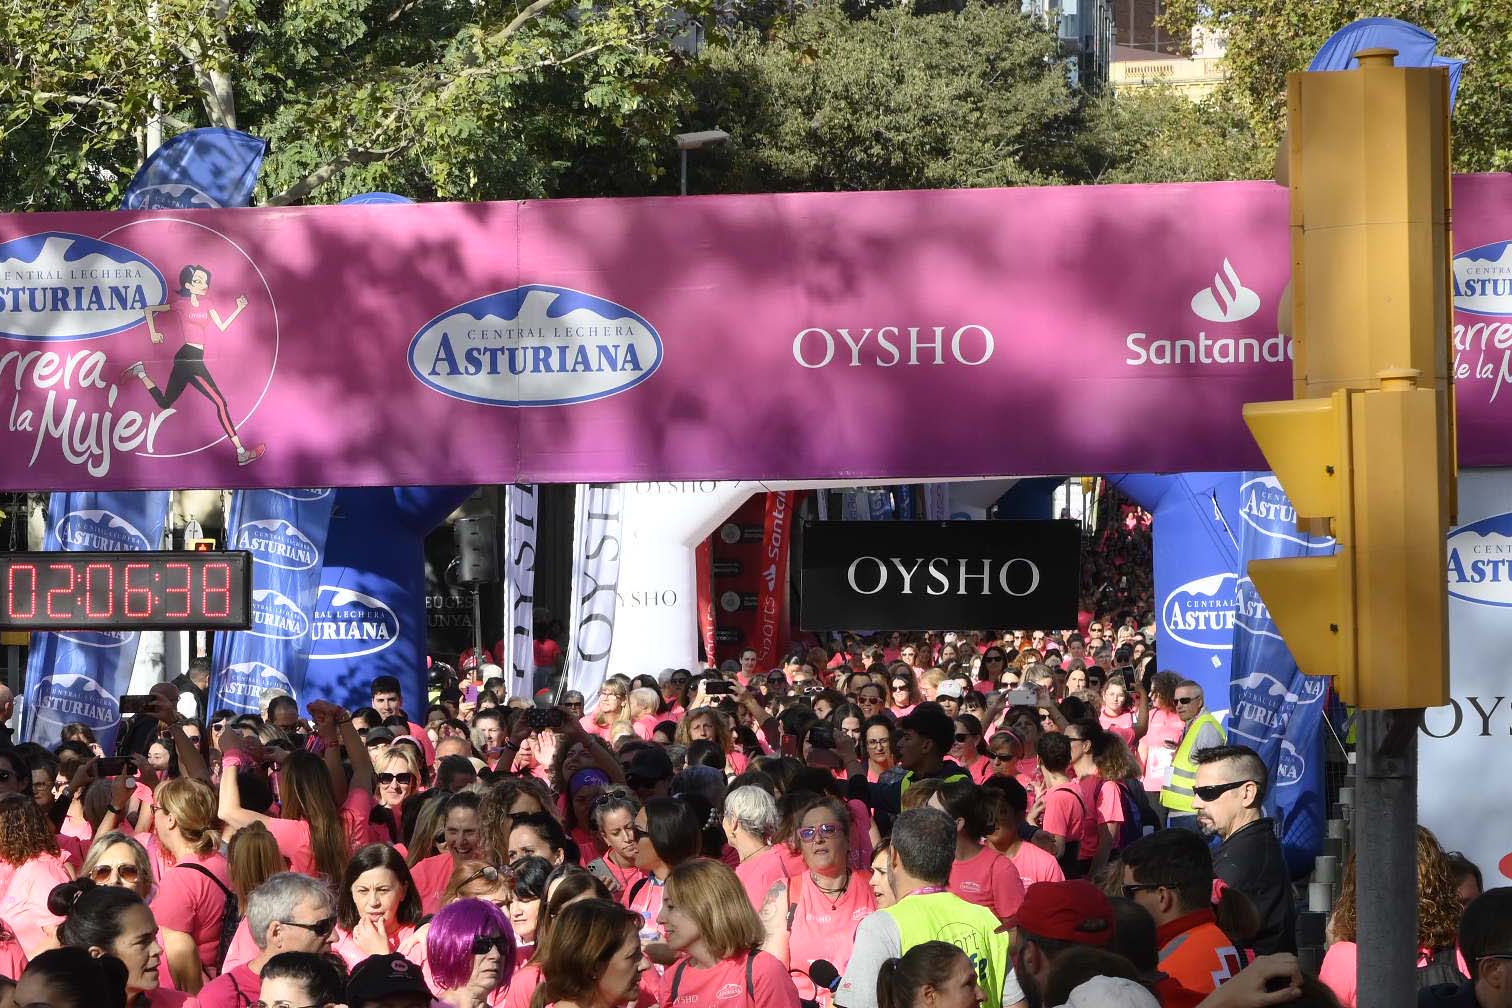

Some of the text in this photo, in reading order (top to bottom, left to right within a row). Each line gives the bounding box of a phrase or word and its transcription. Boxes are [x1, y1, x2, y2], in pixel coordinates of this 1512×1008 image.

[71, 268, 143, 280] LECHERA
[467, 325, 635, 340] CENTRAL LECHERA
[791, 324, 995, 368] OYSHO
[428, 332, 643, 376] ASTURIANA
[1476, 352, 1494, 379] la
[8, 391, 33, 433] la
[28, 384, 177, 478] Mujer
[238, 530, 312, 564] ASTURIANA
[8, 563, 231, 618] 02:06:38
[847, 555, 1040, 597] OYSHO
[1186, 599, 1236, 609] CENTRAL
